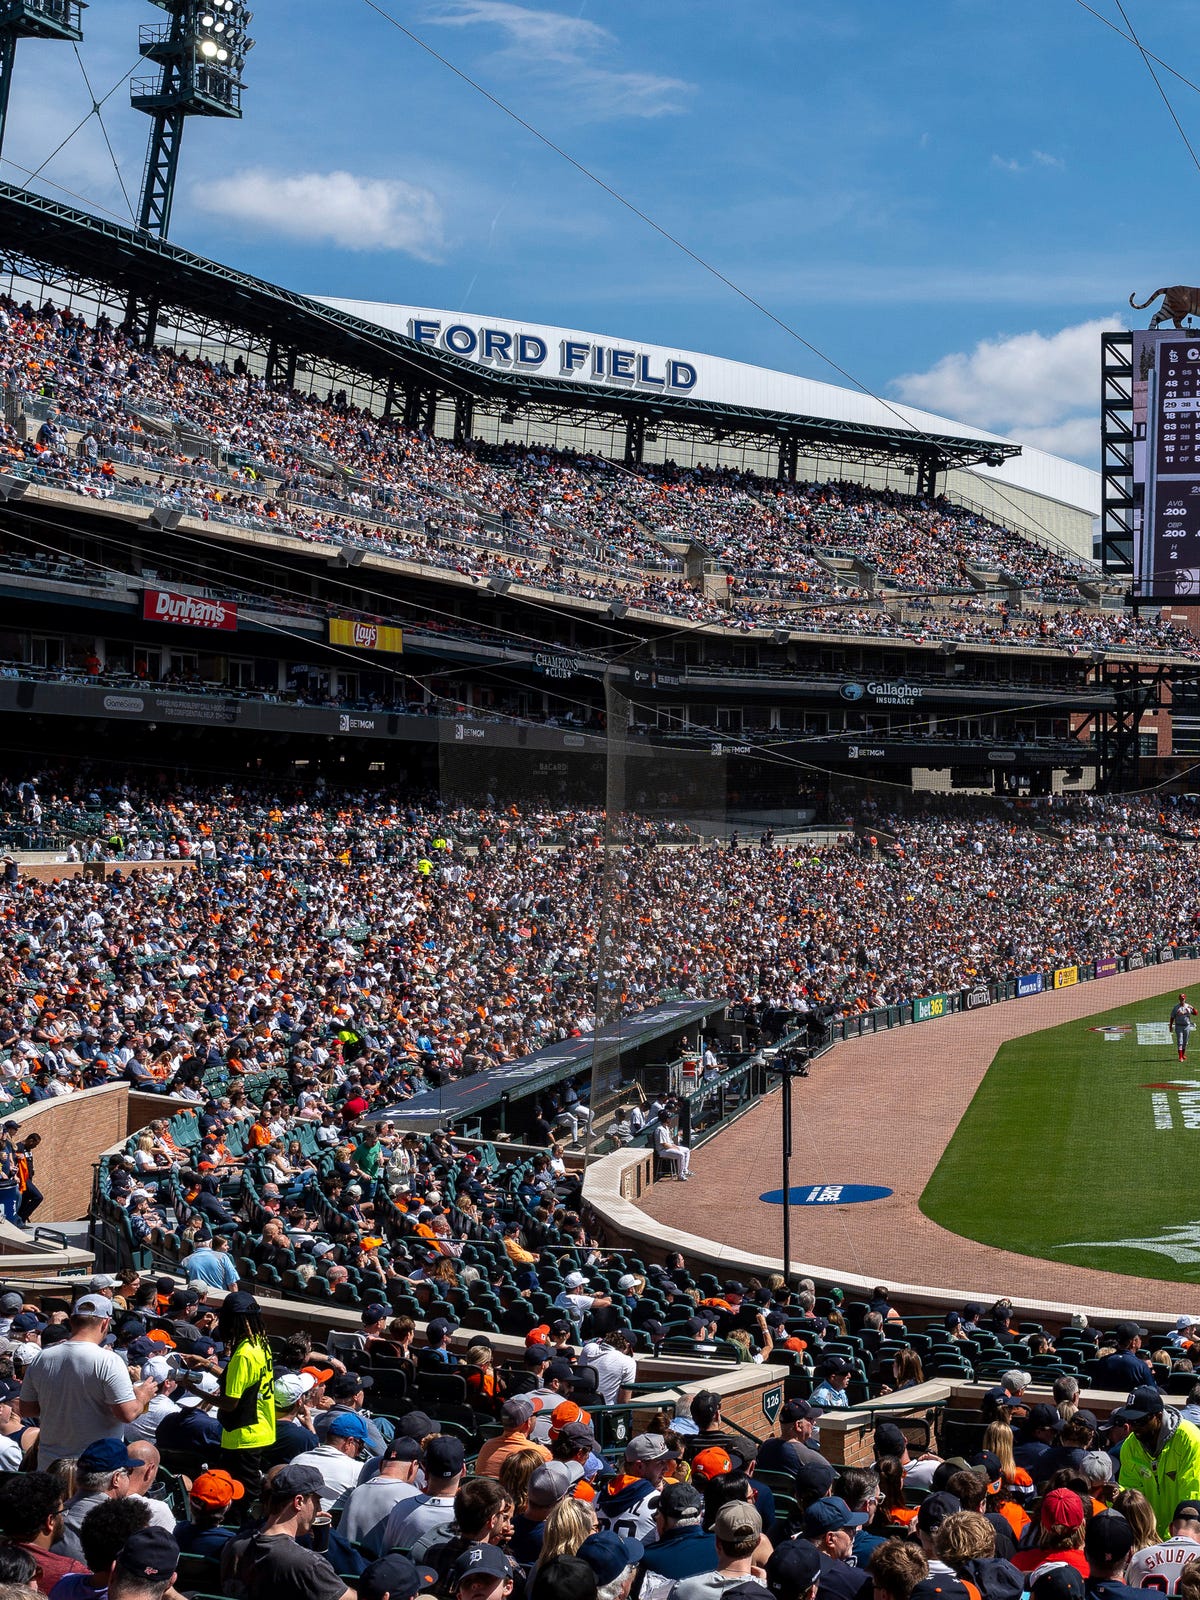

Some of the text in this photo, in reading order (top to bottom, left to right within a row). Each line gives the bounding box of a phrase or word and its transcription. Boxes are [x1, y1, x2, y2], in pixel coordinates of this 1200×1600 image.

[408, 318, 698, 393] FORD FIELD
[156, 593, 225, 623] Dunham's
[163, 615, 219, 628] SPORTS
[355, 623, 376, 646] Lay's
[536, 653, 579, 671] CHAMPIONS
[550, 668, 567, 678] CLUB
[867, 683, 923, 698] Gallagher
[876, 697, 914, 705] INSURANCE
[350, 720, 374, 728] BETMGM
[920, 999, 942, 1018] bet365
[767, 1394, 779, 1408] 126
[1145, 1549, 1197, 1570] SKUBA
